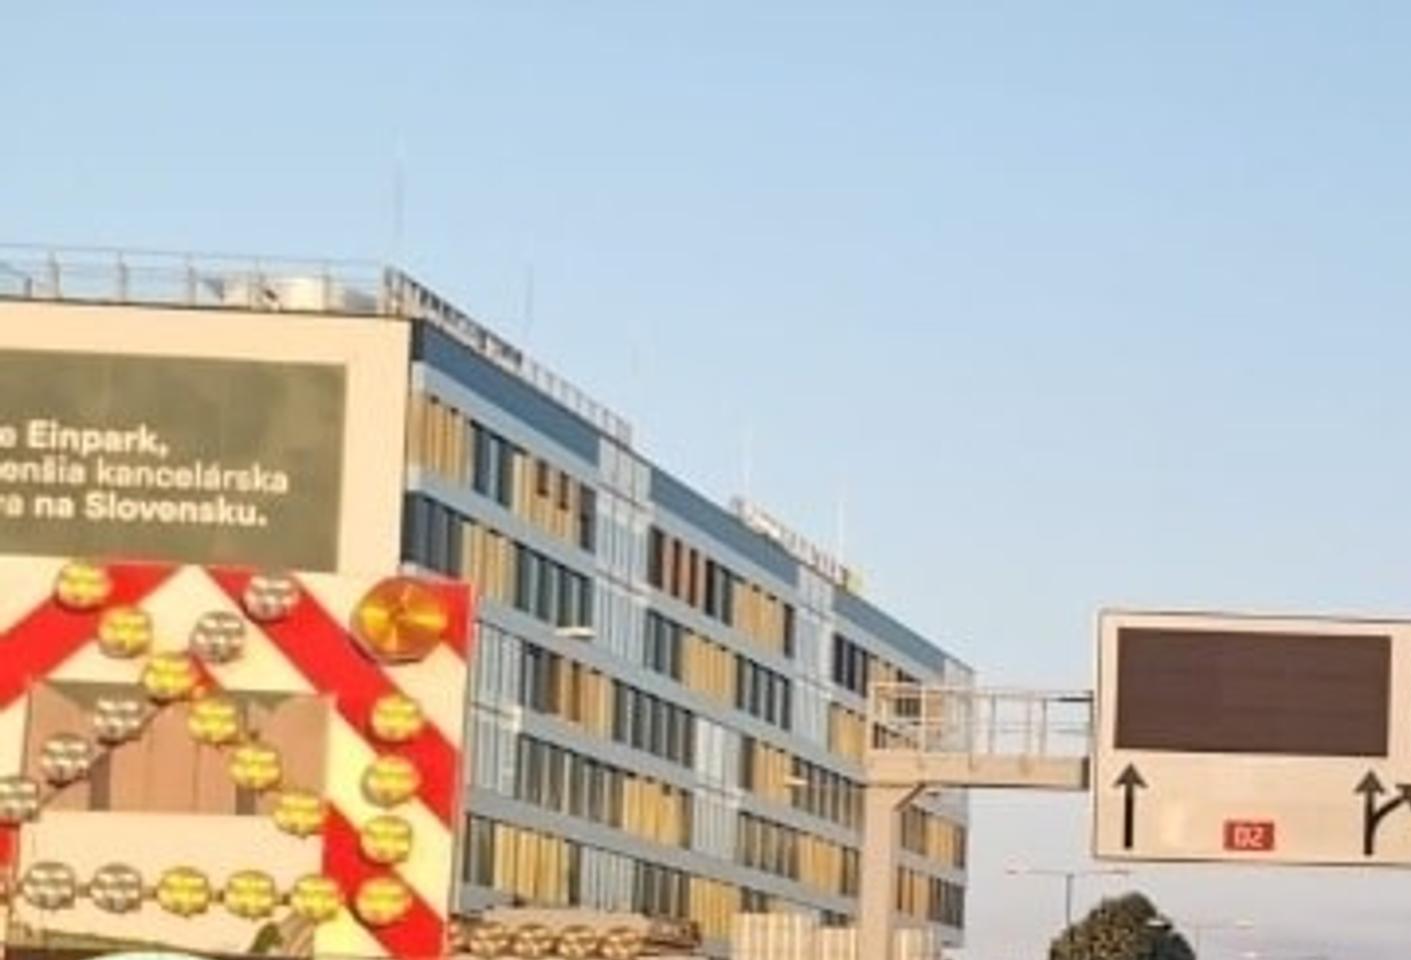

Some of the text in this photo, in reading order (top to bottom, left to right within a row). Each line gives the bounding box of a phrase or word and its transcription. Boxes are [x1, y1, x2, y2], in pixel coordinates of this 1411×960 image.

[27, 418, 169, 457] Einpark,
[97, 456, 289, 494] kancelárska
[34, 496, 75, 519] na
[84, 489, 268, 527] Slovensku.
[1234, 826, 1264, 848] D2
